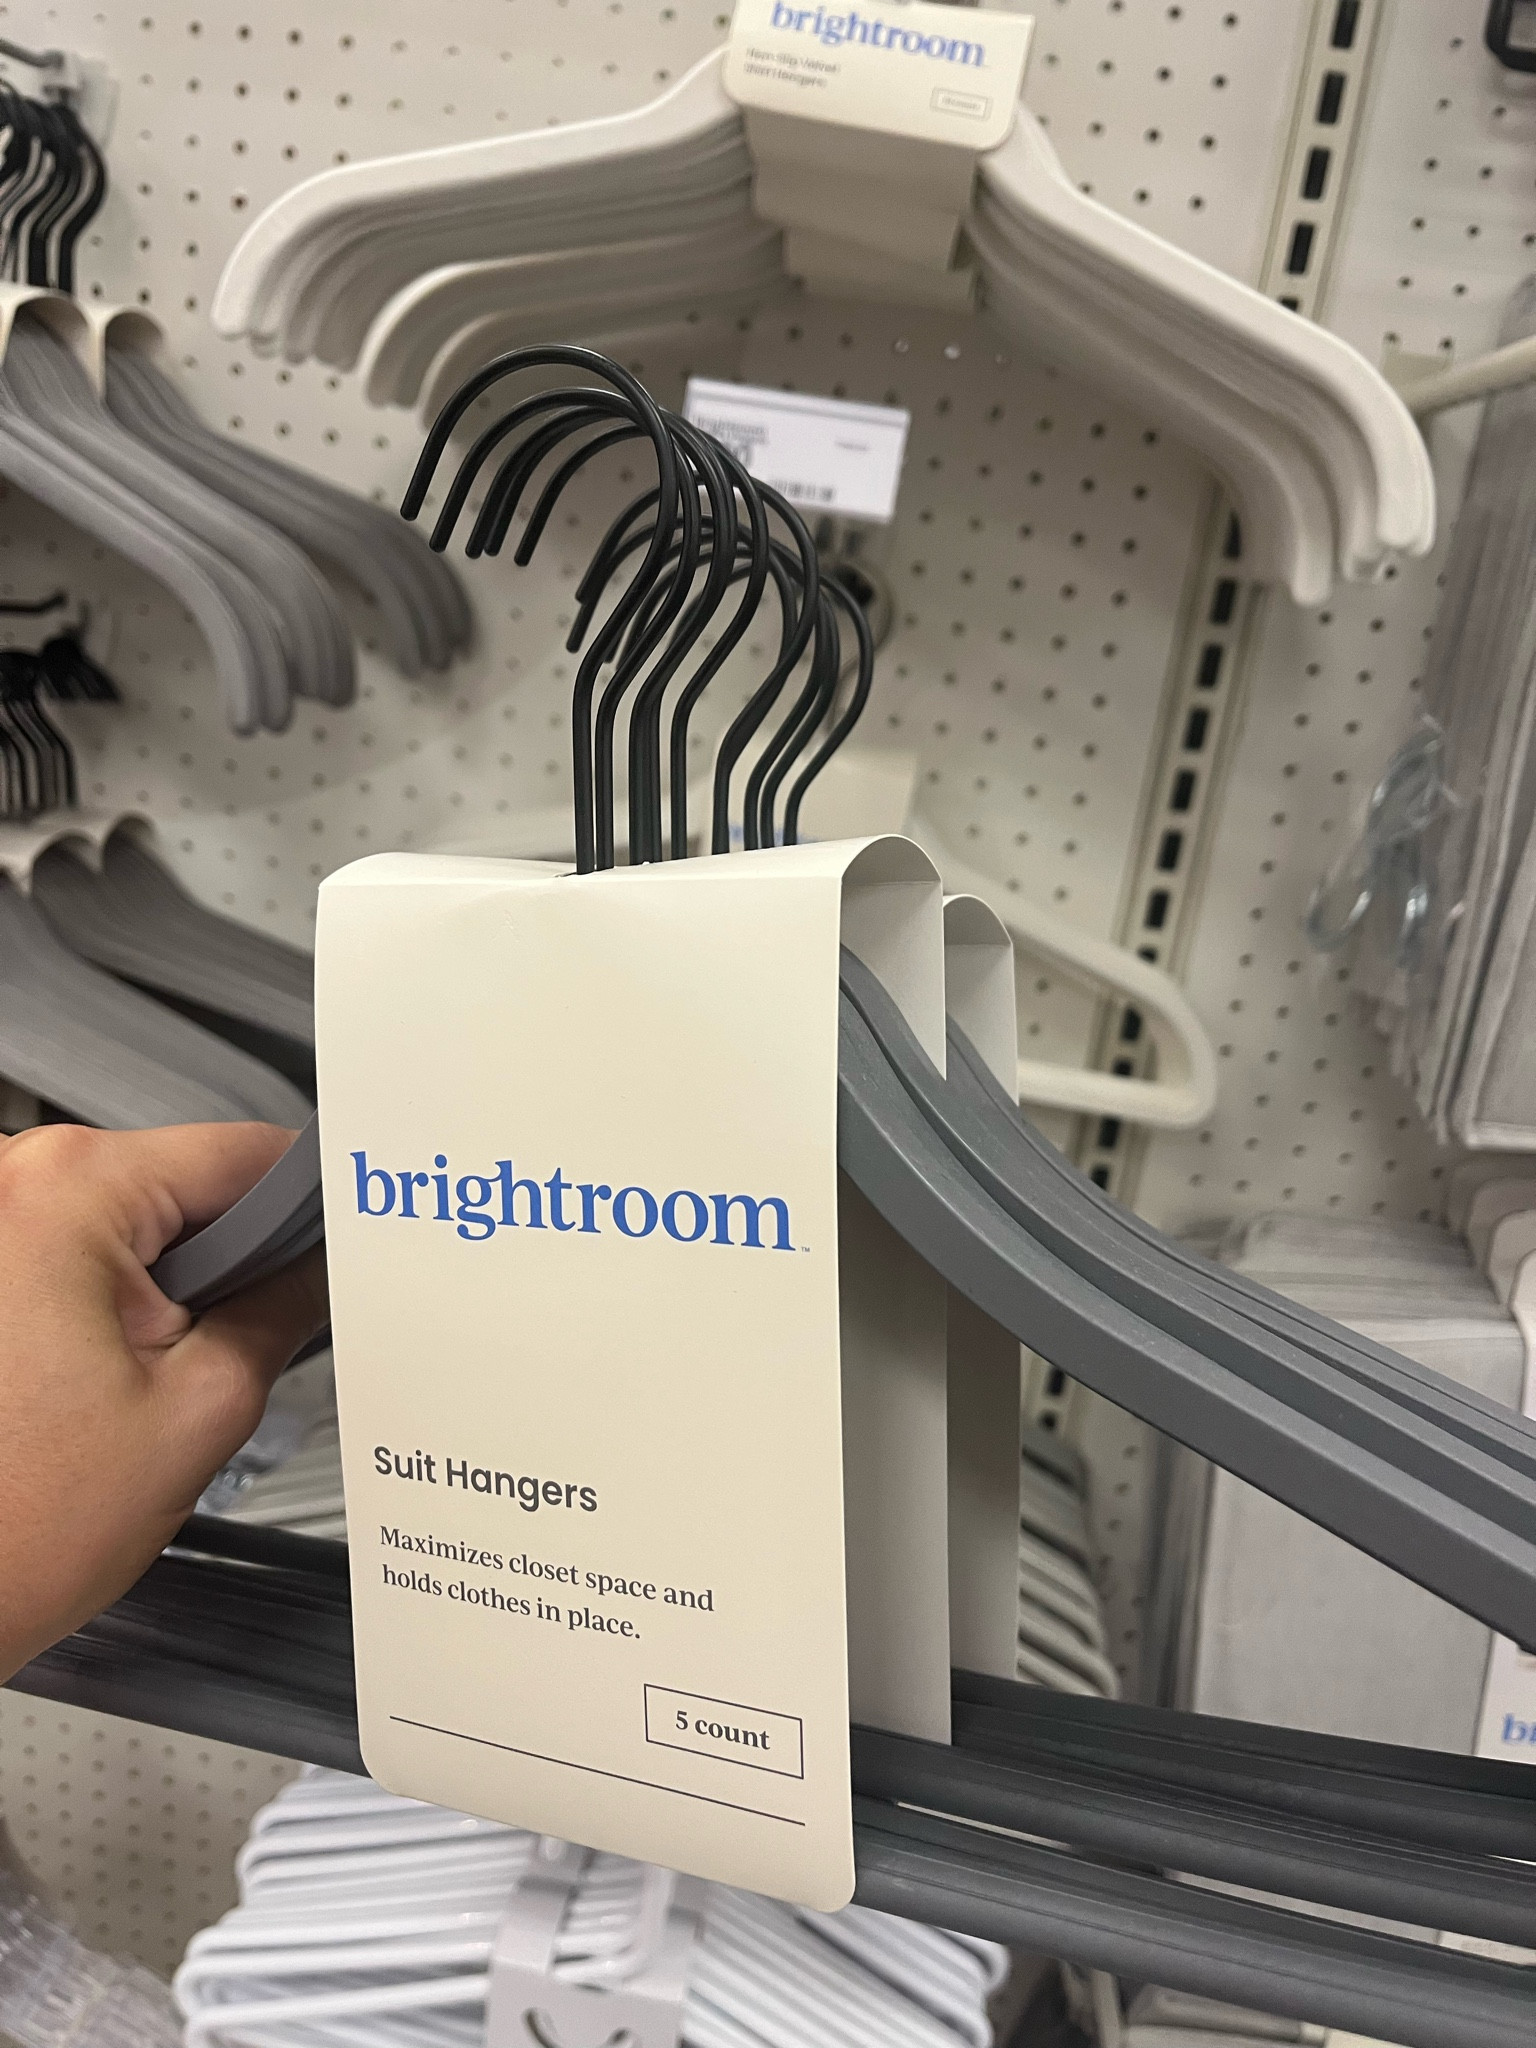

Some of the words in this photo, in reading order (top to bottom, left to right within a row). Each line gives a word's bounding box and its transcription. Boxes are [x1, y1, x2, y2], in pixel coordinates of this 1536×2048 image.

[770, 1, 985, 67] brightroom
[349, 1150, 796, 1252] brightroom
[374, 1446, 437, 1484] Suit
[446, 1457, 598, 1513] Hangers
[380, 1525, 504, 1571] Maximizes
[508, 1553, 580, 1586] closet
[585, 1572, 657, 1602] space
[663, 1587, 715, 1612] and
[382, 1563, 443, 1597] holds
[447, 1580, 531, 1617] clothes
[536, 1596, 562, 1624] in
[567, 1607, 641, 1640] place.
[675, 1709, 689, 1731] 5
[694, 1718, 771, 1751] count
